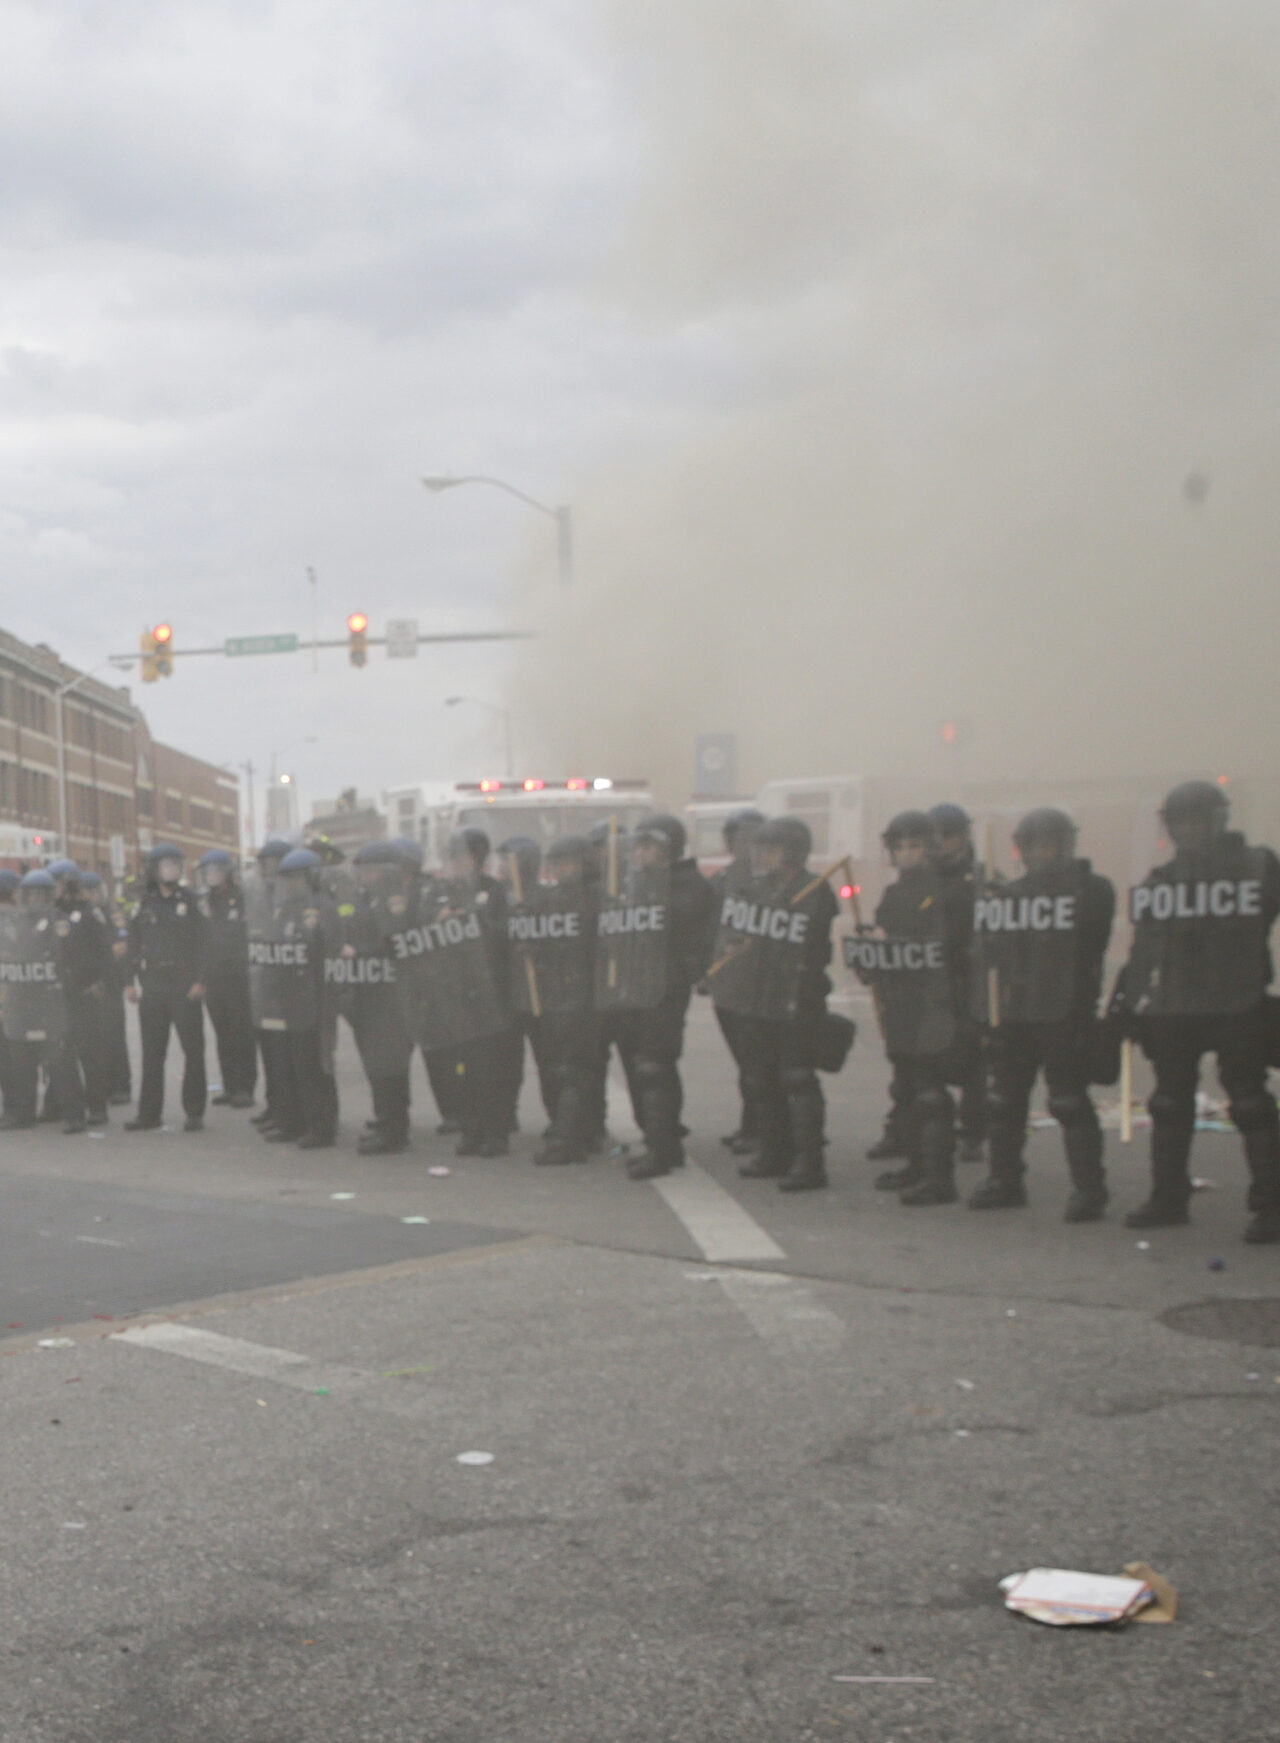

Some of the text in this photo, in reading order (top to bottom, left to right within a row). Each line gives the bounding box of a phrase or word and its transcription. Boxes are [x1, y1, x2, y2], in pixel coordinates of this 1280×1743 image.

[973, 895, 1076, 932] POLICE
[1132, 880, 1262, 921] POLICE
[391, 912, 481, 959] POLICE
[508, 911, 580, 940] POLICE
[597, 905, 665, 936] POLICE
[720, 896, 810, 944] POLICE
[248, 942, 308, 965] POLICE
[845, 941, 945, 970] POLICE
[323, 957, 397, 984] POLICE
